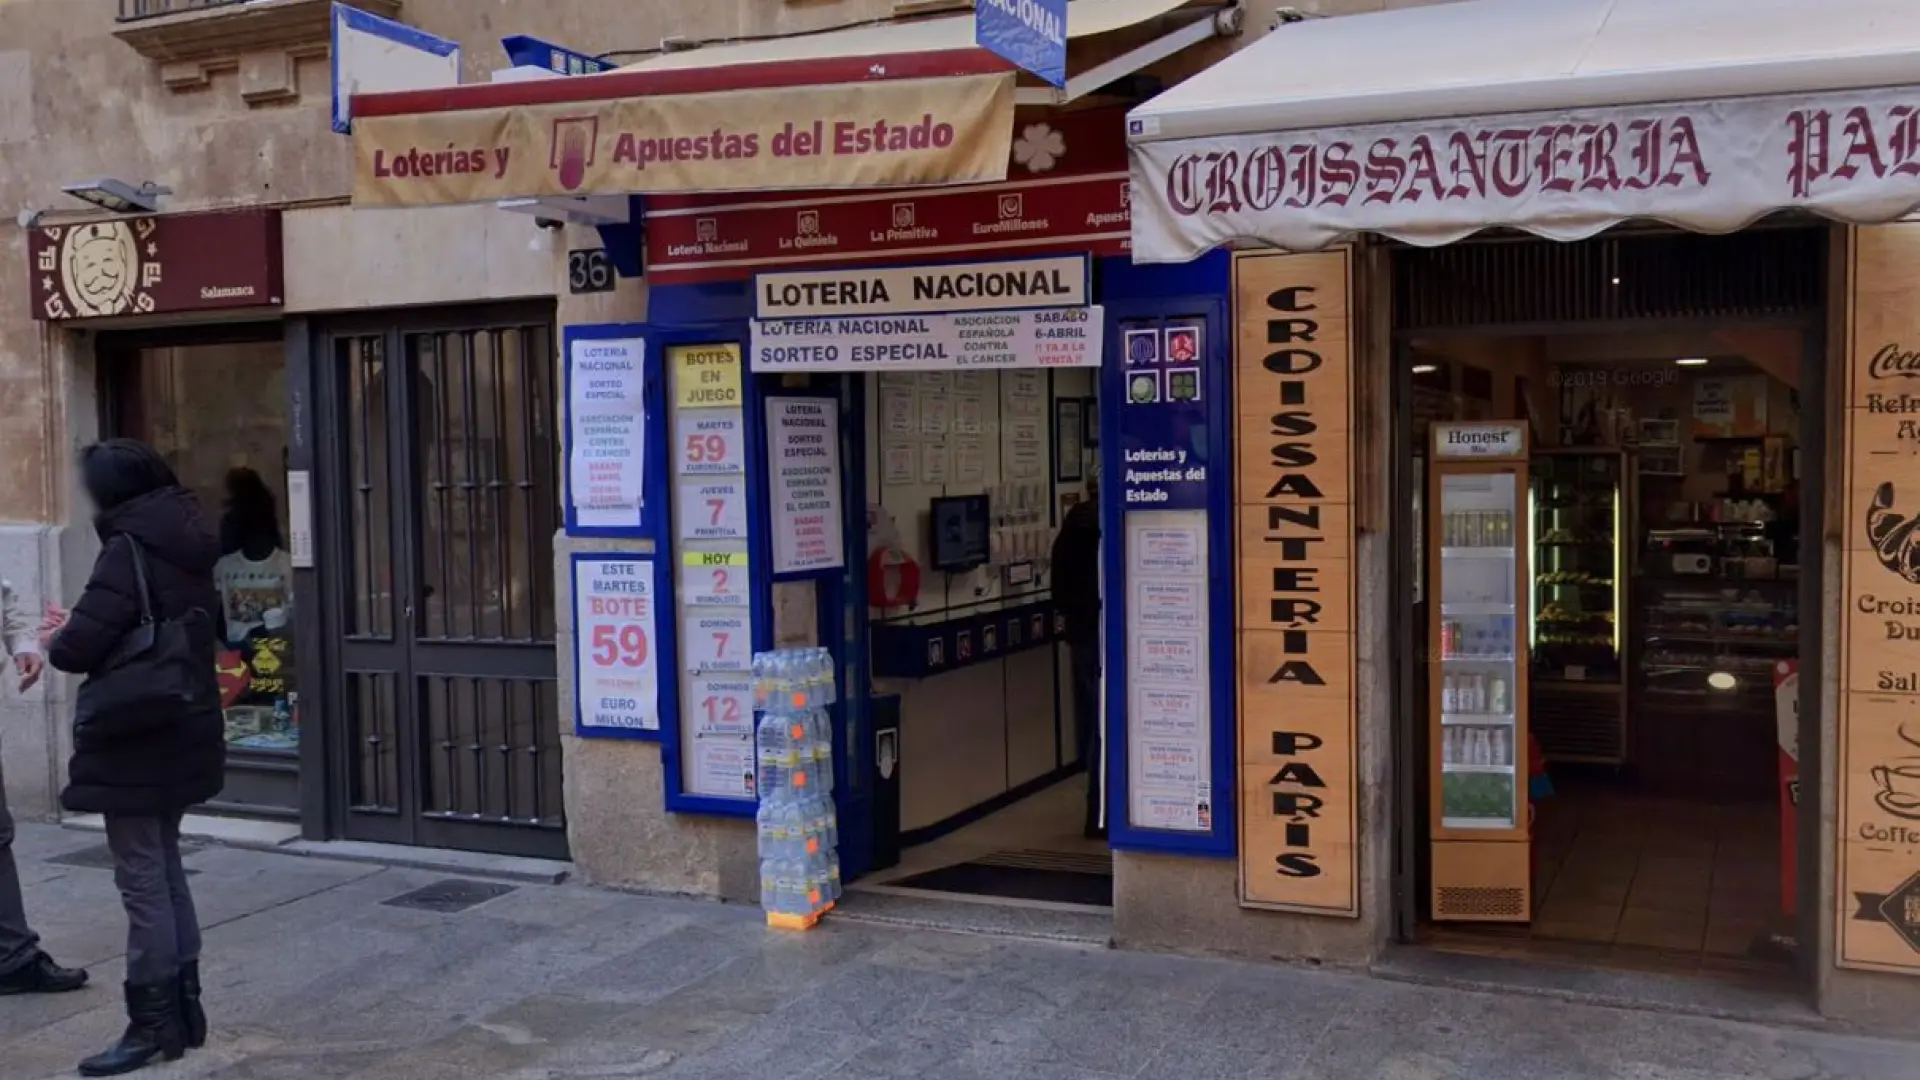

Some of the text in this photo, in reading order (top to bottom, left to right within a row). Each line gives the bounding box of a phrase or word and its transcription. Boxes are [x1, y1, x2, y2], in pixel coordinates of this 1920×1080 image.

[374, 113, 953, 178] Loterías y Apuestas del Estado
[1167, 114, 1710, 216] CROISSANTERIA
[972, 218, 1049, 234] EuroMillones
[779, 234, 838, 249] La Quiniela
[871, 226, 938, 242] La Primitiva
[706, 239, 748, 253] Nacional
[571, 252, 607, 288] 36
[200, 285, 254, 298] Salamanca
[766, 269, 1071, 307] LOTERIA NACIONAL
[761, 318, 930, 336] LOTERIA NACIONAL
[958, 327, 1015, 339] ESPAÑOLA
[761, 342, 948, 363] SORTEO ESPECIAL
[964, 341, 1009, 351] CONTRA
[580, 361, 633, 370] NACIONAL
[686, 351, 734, 366] BOTES
[957, 354, 968, 364] EL
[701, 370, 720, 383] EN
[686, 388, 736, 402] JUEGO
[697, 421, 734, 430] MARTES
[1448, 430, 1510, 444] Honest
[686, 434, 726, 463] 59
[1179, 449, 1187, 463] y
[1125, 465, 1205, 484] Apuestas del
[1126, 487, 1168, 502] Estado
[706, 498, 725, 526] 7
[702, 553, 731, 565] HOY
[602, 564, 634, 575] ESTE
[593, 580, 645, 593] MARTES
[712, 568, 730, 594] 2
[591, 597, 647, 616] BOTE
[699, 619, 741, 628] DOMINGO
[591, 624, 648, 667] 59
[712, 632, 729, 658] 7
[601, 697, 636, 711] EURO
[702, 695, 741, 722] 12
[595, 714, 644, 728] MILLON
